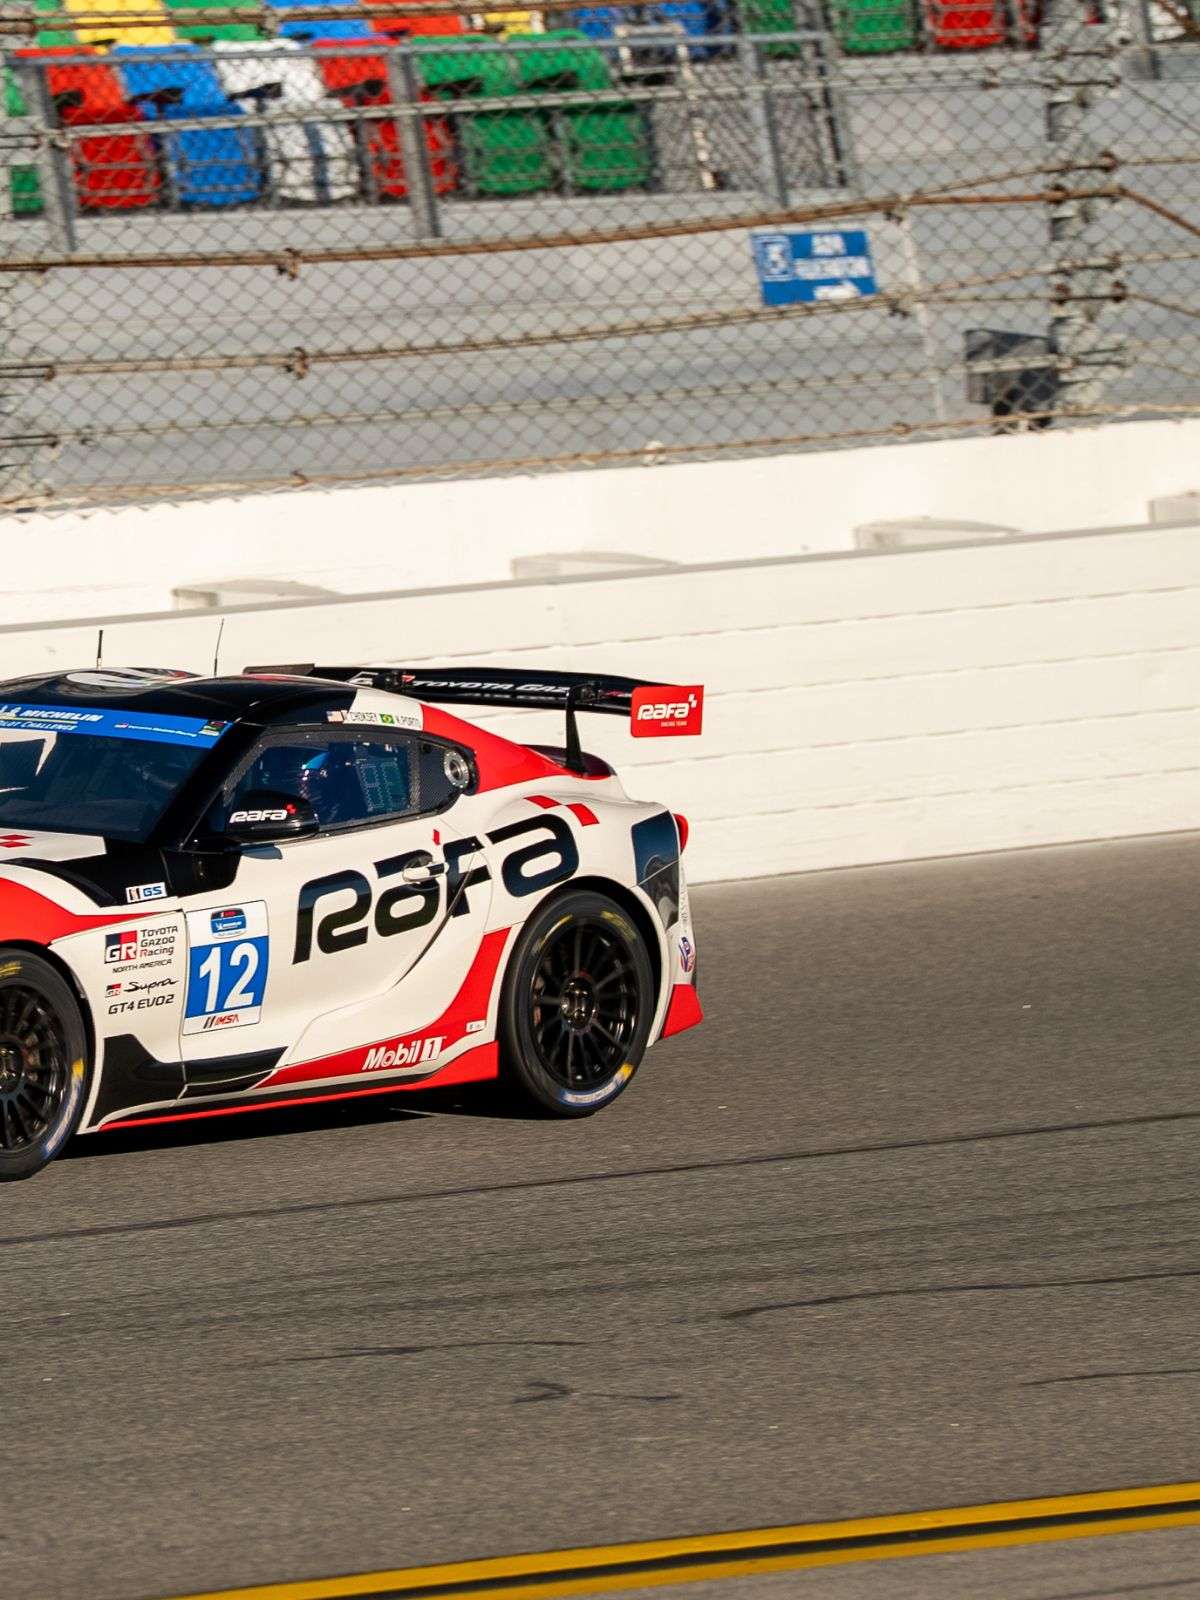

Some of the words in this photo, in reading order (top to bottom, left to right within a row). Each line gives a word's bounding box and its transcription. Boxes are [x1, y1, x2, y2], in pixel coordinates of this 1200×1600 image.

[412, 680, 515, 690] TOYOTA
[516, 683, 571, 693] GAZ
[19, 709, 105, 722] MICHELIN
[21, 720, 79, 731] CHALLENGE
[143, 885, 163, 898] GS
[140, 925, 178, 938] TOYOTA
[140, 936, 176, 948] GAZOO
[105, 941, 138, 963] GR
[139, 946, 175, 958] Racing
[112, 963, 138, 974] NORTH
[139, 958, 173, 970] AMERICA
[199, 941, 260, 1014] 12
[123, 977, 179, 995] Supra
[108, 1001, 135, 1015] GT4
[136, 993, 175, 1010] EVO2
[213, 1013, 240, 1027] IMSA
[361, 1039, 422, 1071] Mobil
